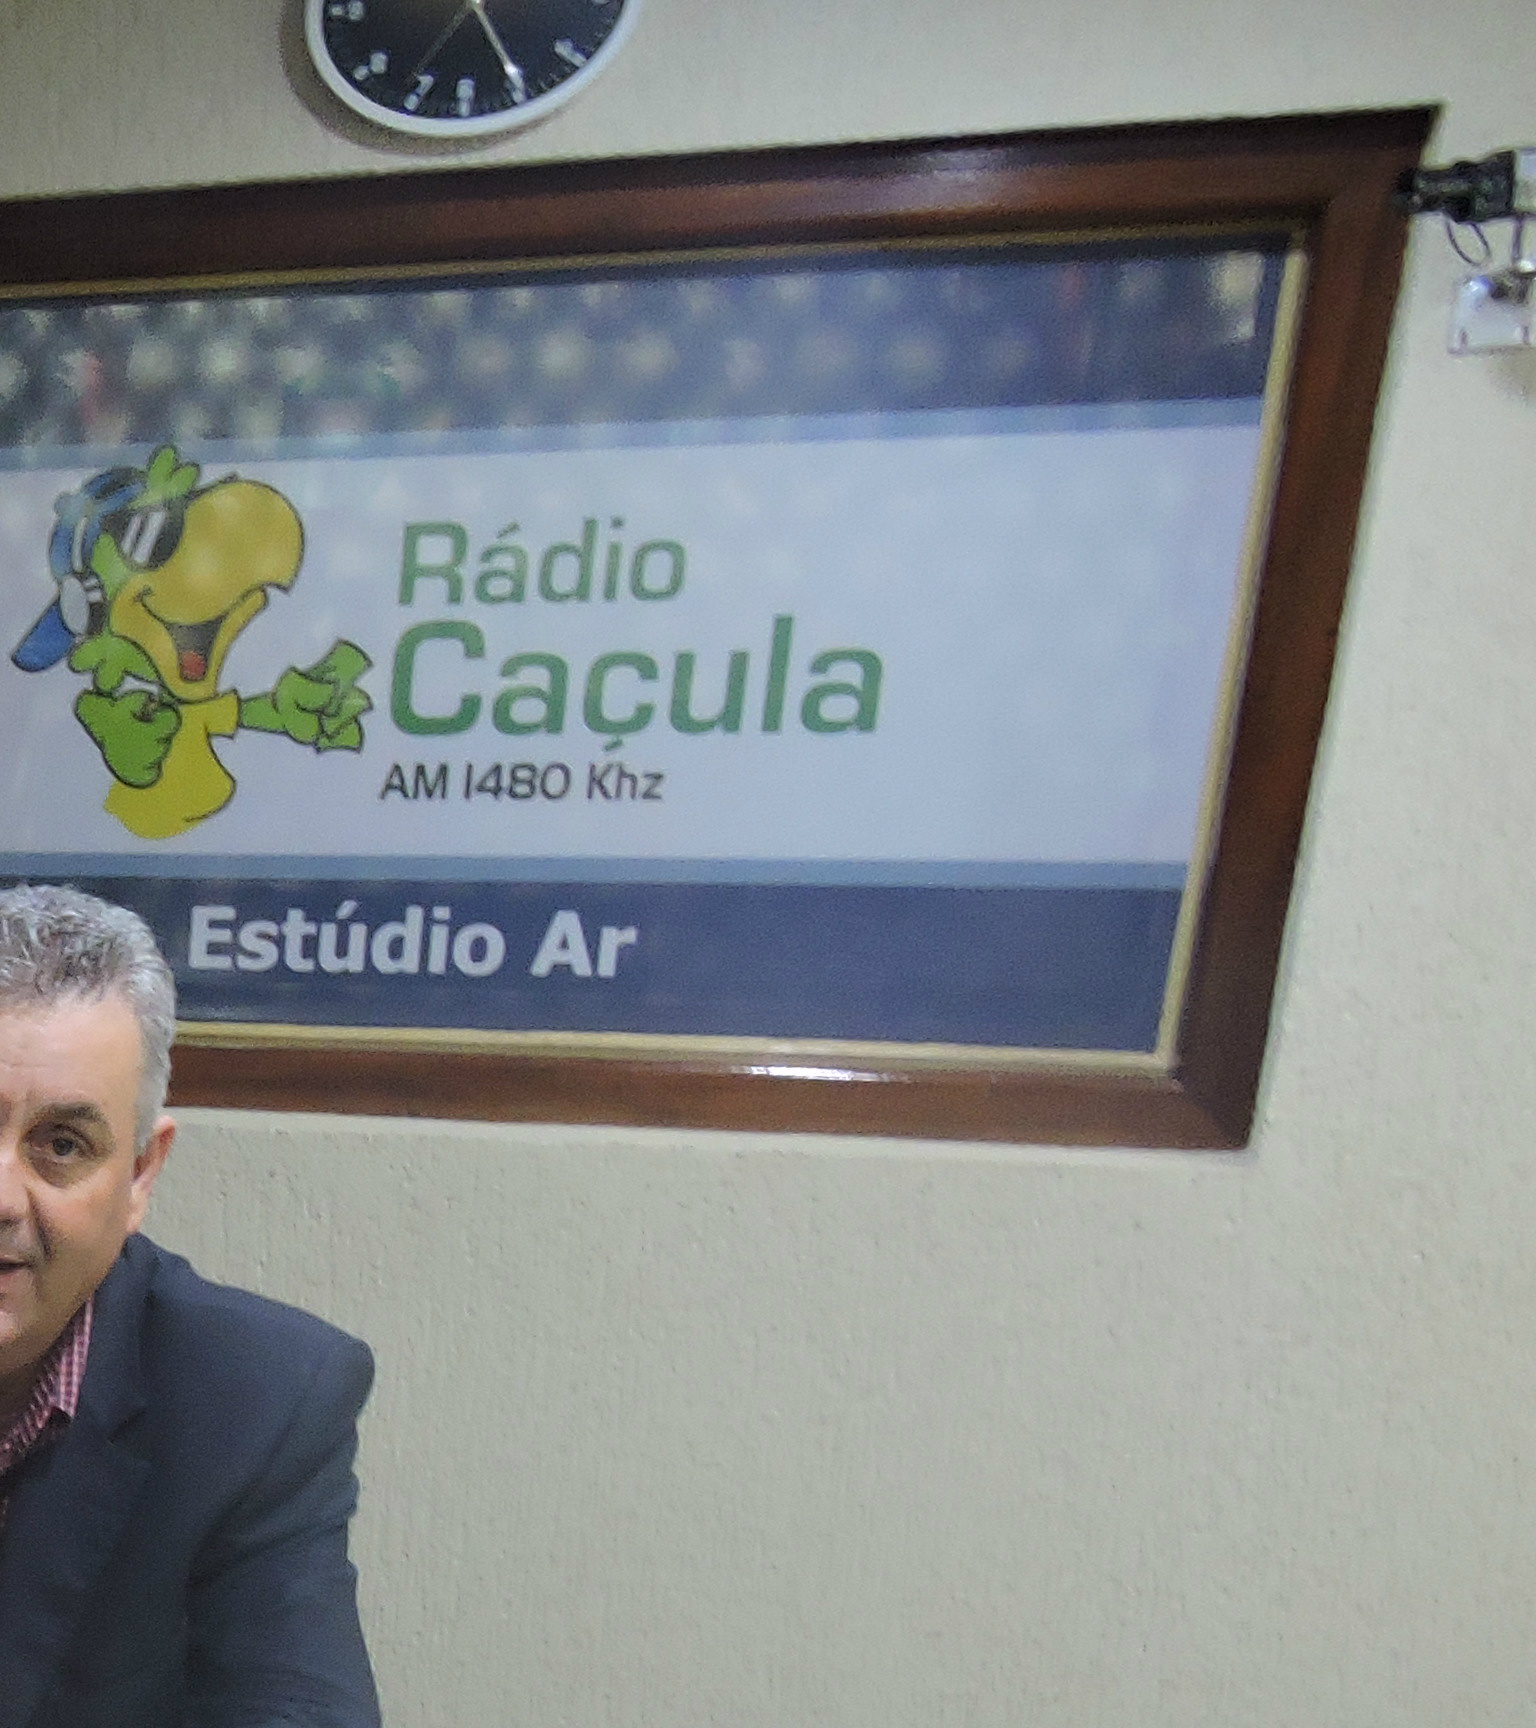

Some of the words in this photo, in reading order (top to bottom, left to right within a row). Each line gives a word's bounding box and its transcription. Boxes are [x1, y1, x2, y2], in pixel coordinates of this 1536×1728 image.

[398, 517, 687, 605] Rádio
[390, 613, 884, 752] Caçula
[381, 762, 449, 800] AM
[463, 762, 571, 800] 1480
[587, 762, 664, 800] Khz
[188, 900, 506, 977] Estúdio
[530, 909, 638, 978] Ar
